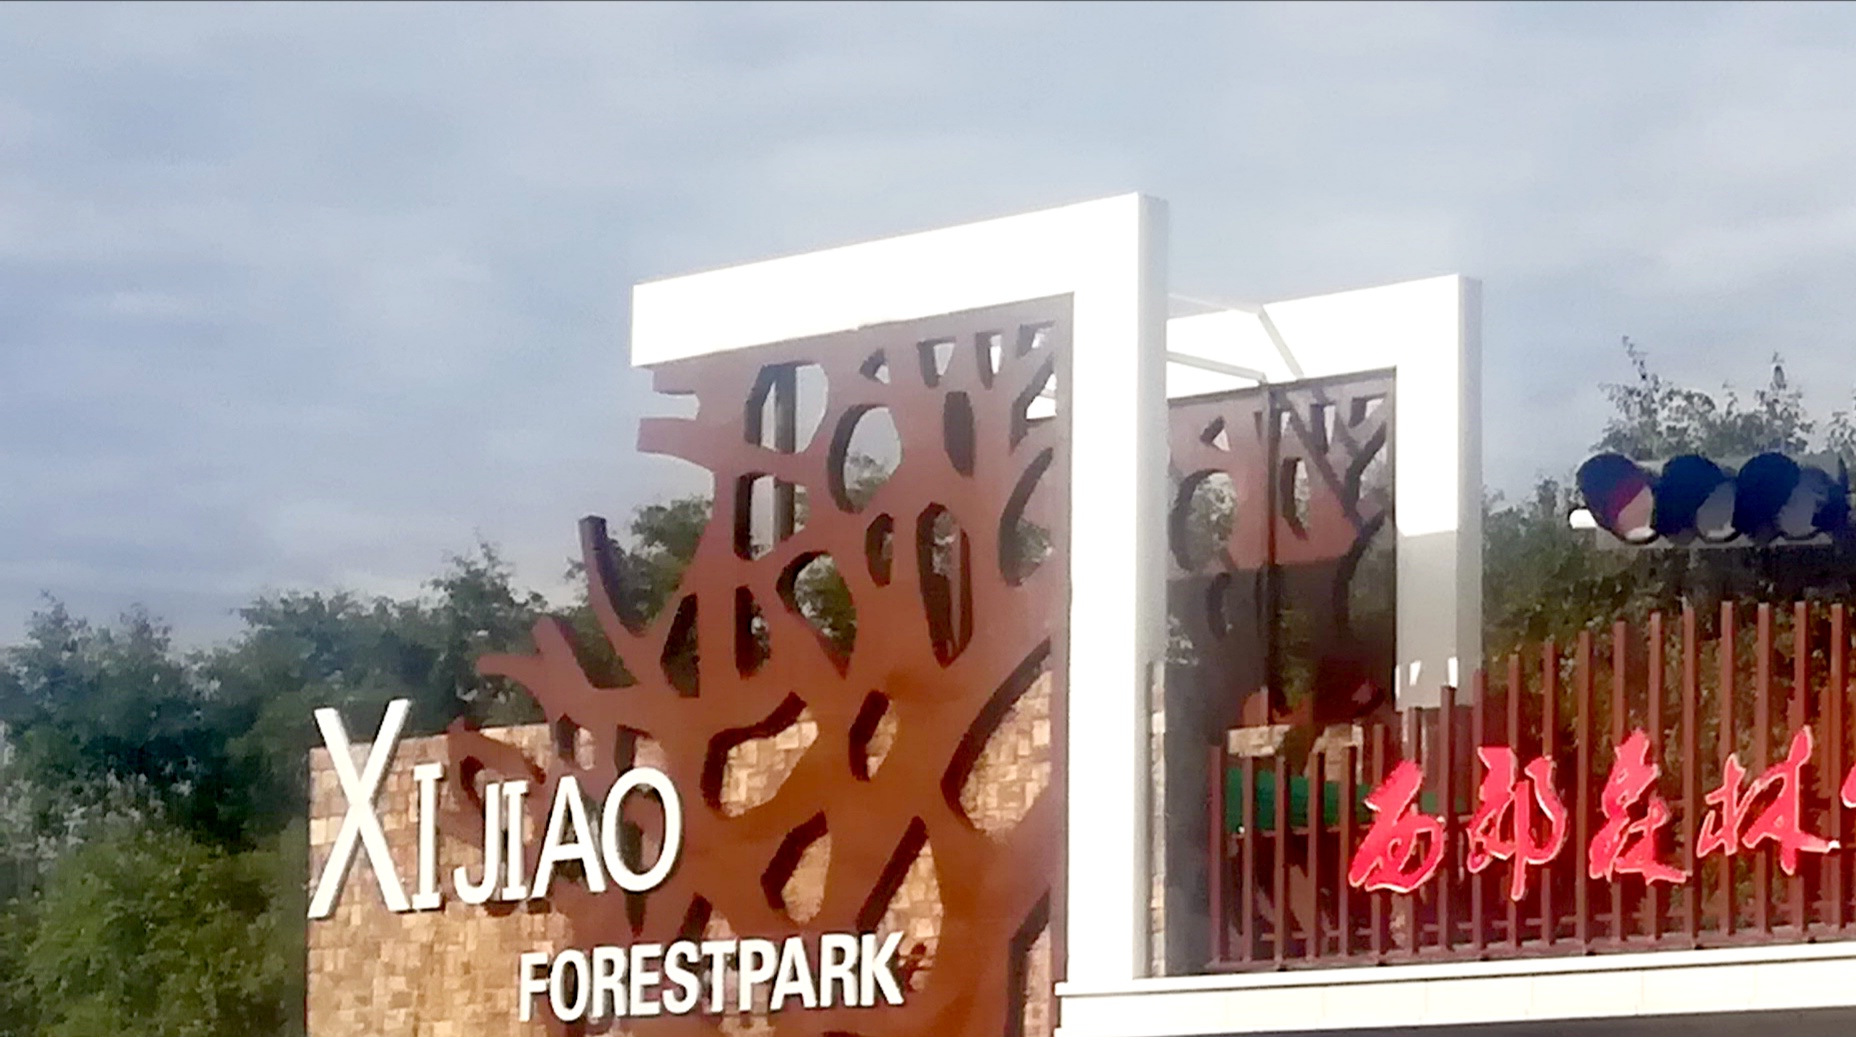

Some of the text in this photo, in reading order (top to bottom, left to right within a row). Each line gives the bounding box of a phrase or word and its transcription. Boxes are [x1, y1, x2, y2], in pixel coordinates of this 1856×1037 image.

[307, 698, 683, 920] XI JIAO
[518, 931, 904, 1022] FORESTPARK
